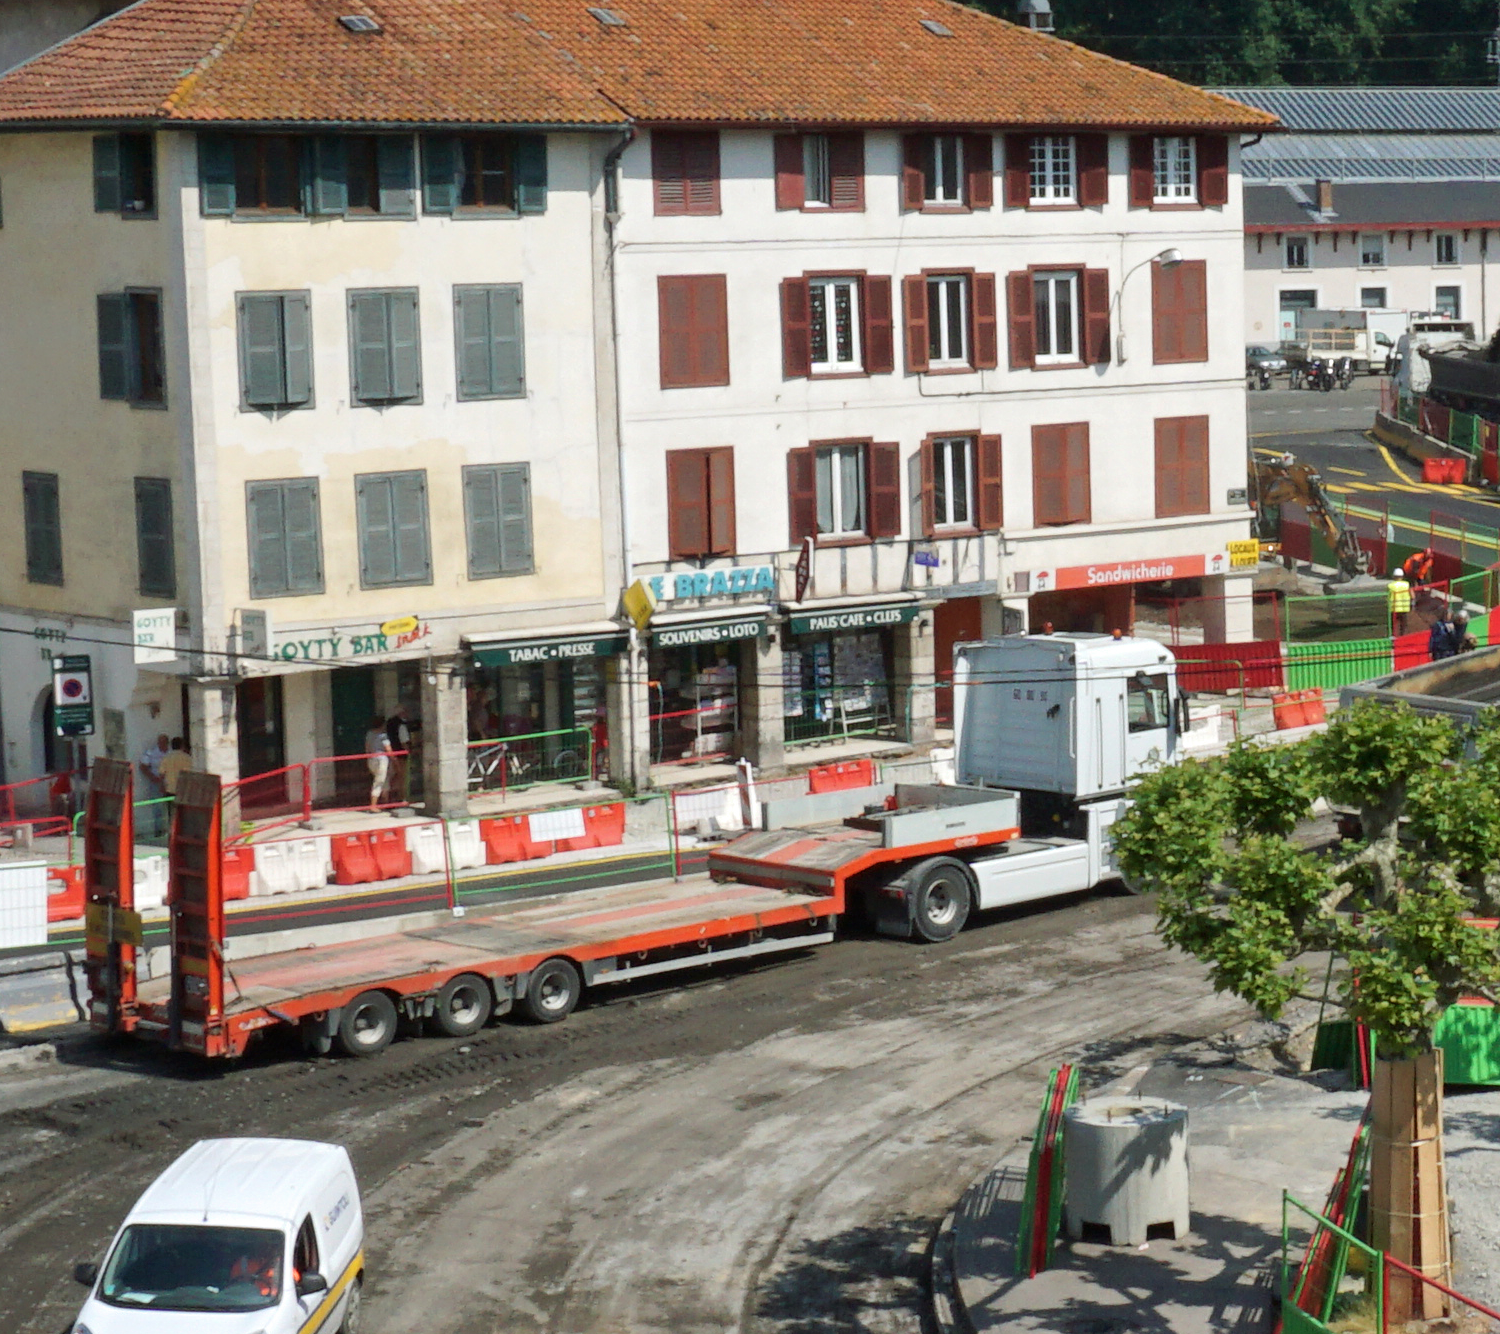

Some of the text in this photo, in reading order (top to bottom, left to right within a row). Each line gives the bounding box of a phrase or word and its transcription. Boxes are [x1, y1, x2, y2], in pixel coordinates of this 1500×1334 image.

[676, 567, 775, 599] BRAZZA
[1087, 563, 1174, 584] Sandwicherie
[352, 633, 389, 655] BAR
[659, 623, 758, 646] SOUVENIRS LOTO
[509, 642, 595, 663] TABAC PRESSE
